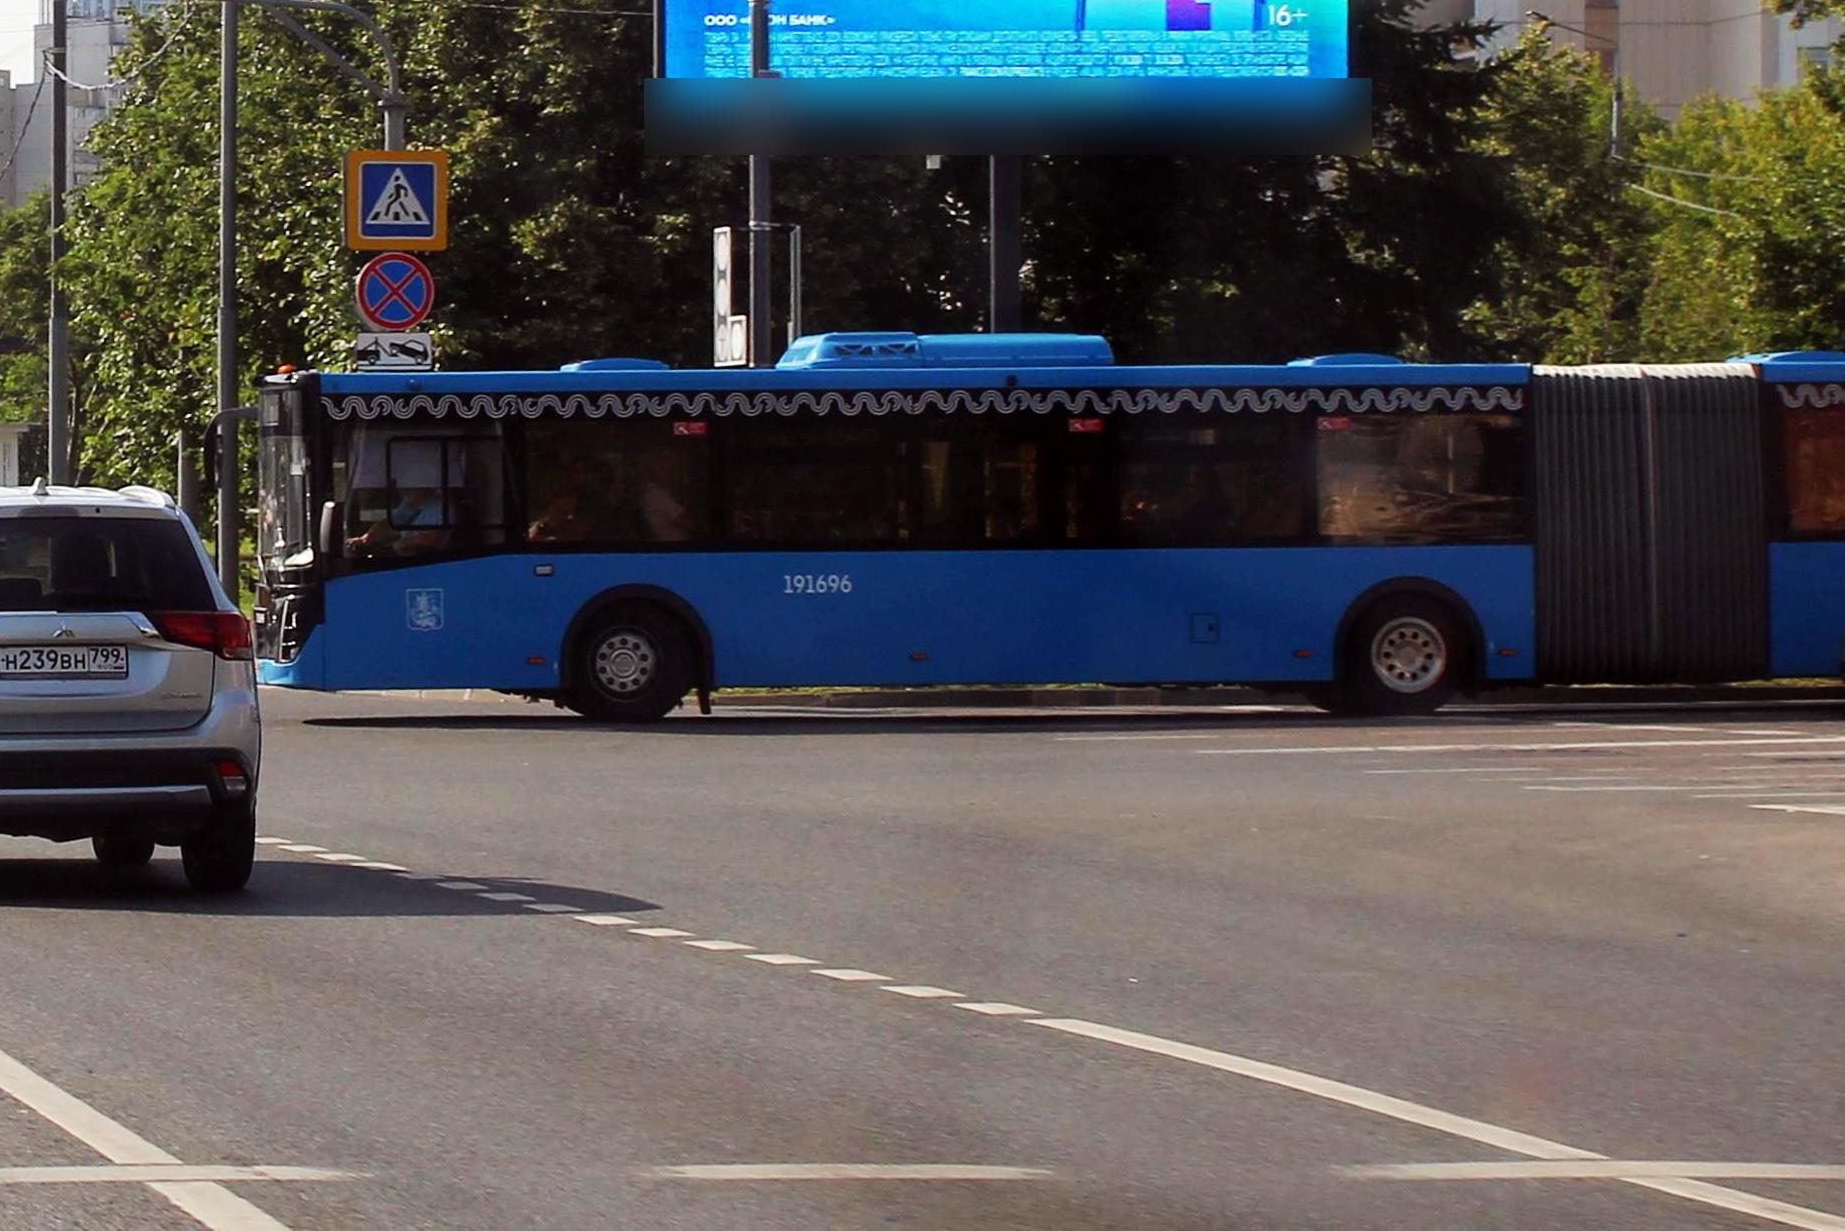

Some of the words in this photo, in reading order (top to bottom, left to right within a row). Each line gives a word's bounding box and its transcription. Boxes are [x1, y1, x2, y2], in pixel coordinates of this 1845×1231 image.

[704, 14, 737, 26] ООО
[1268, 4, 1307, 27] 16+
[784, 574, 852, 594] 191696
[5, 649, 86, 670] Н239ВН
[90, 648, 120, 664] 799
